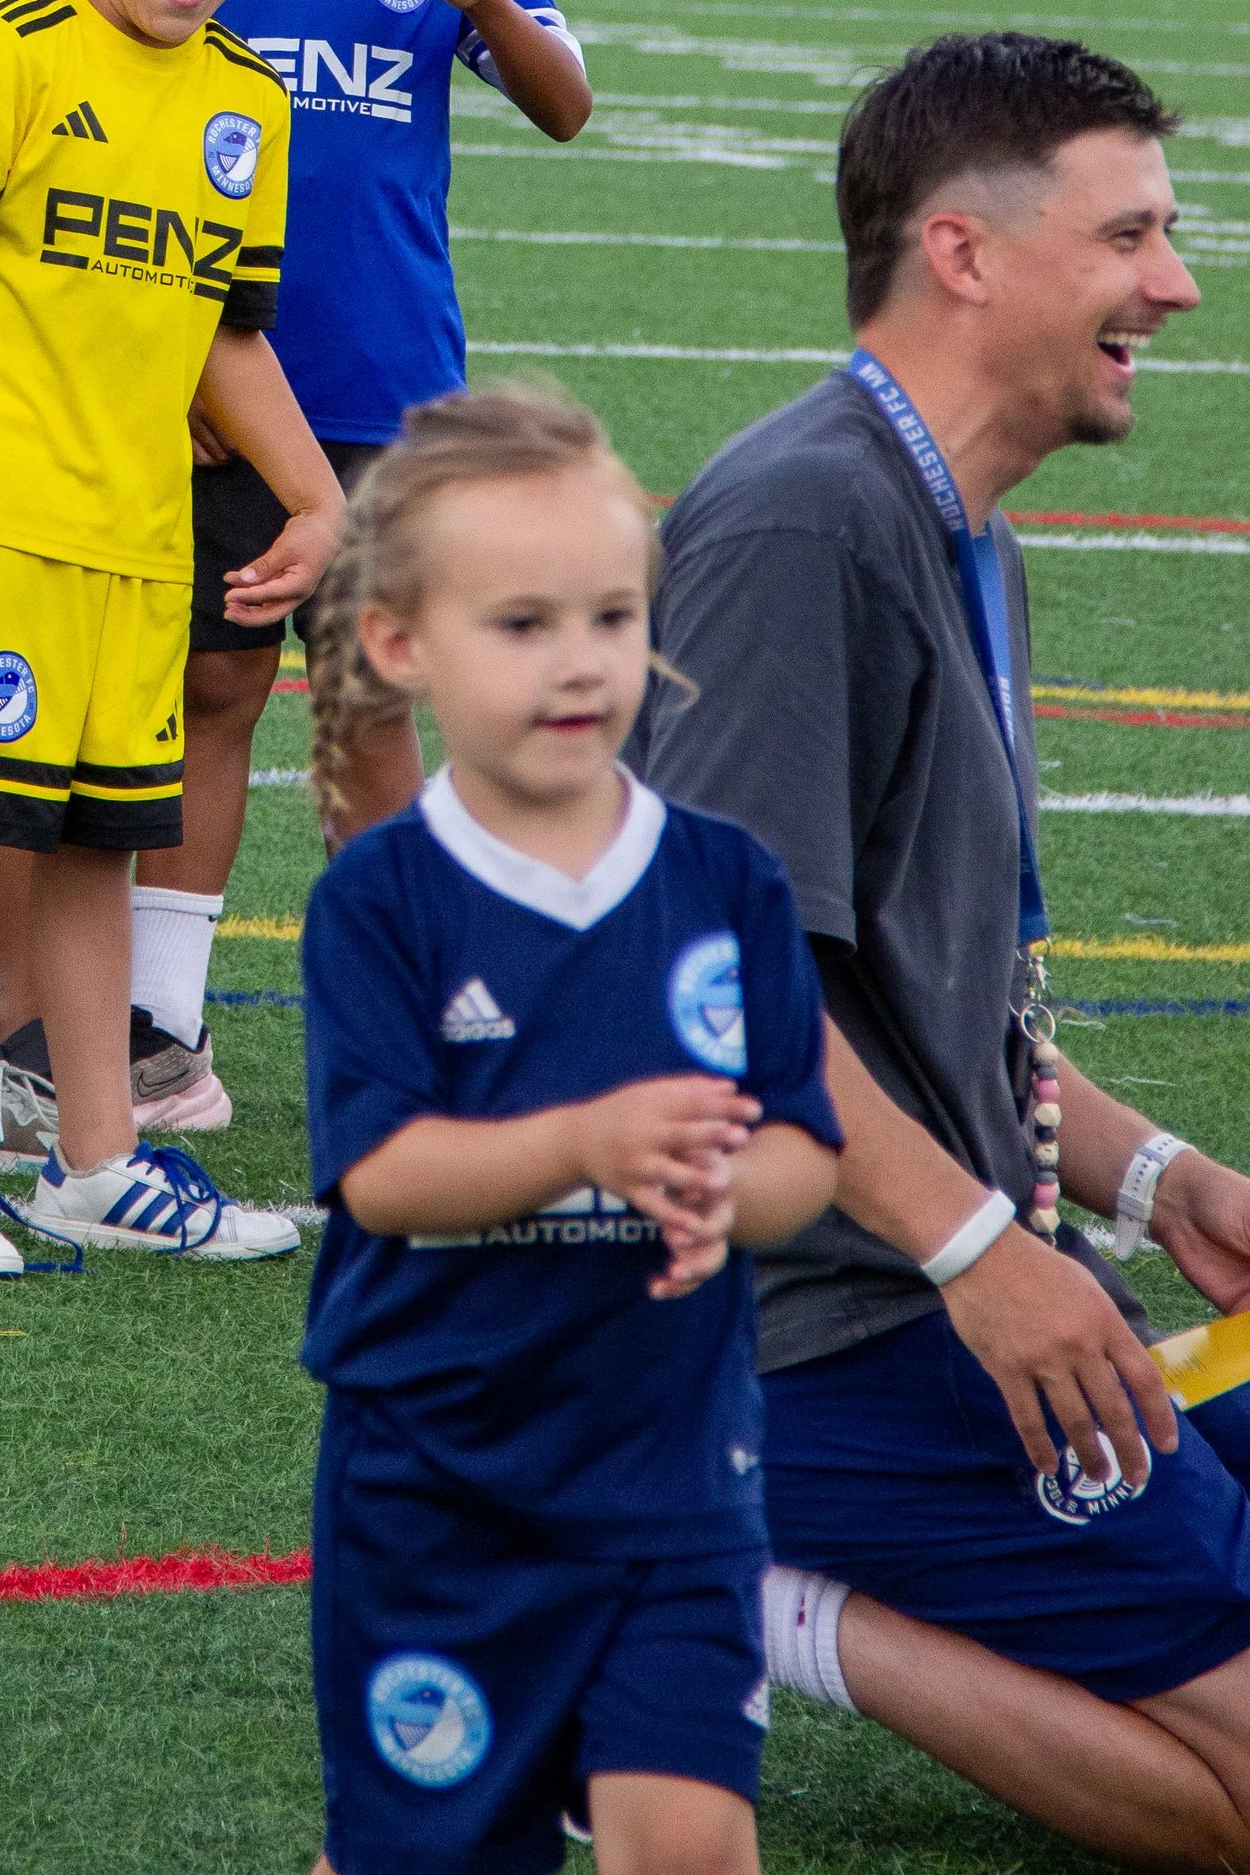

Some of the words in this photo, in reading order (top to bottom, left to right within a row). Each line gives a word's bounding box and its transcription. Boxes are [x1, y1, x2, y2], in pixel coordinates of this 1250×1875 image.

[293, 96, 372, 115] MOTIVE
[207, 117, 257, 144] ROCHESTER
[42, 187, 244, 286] PENZ
